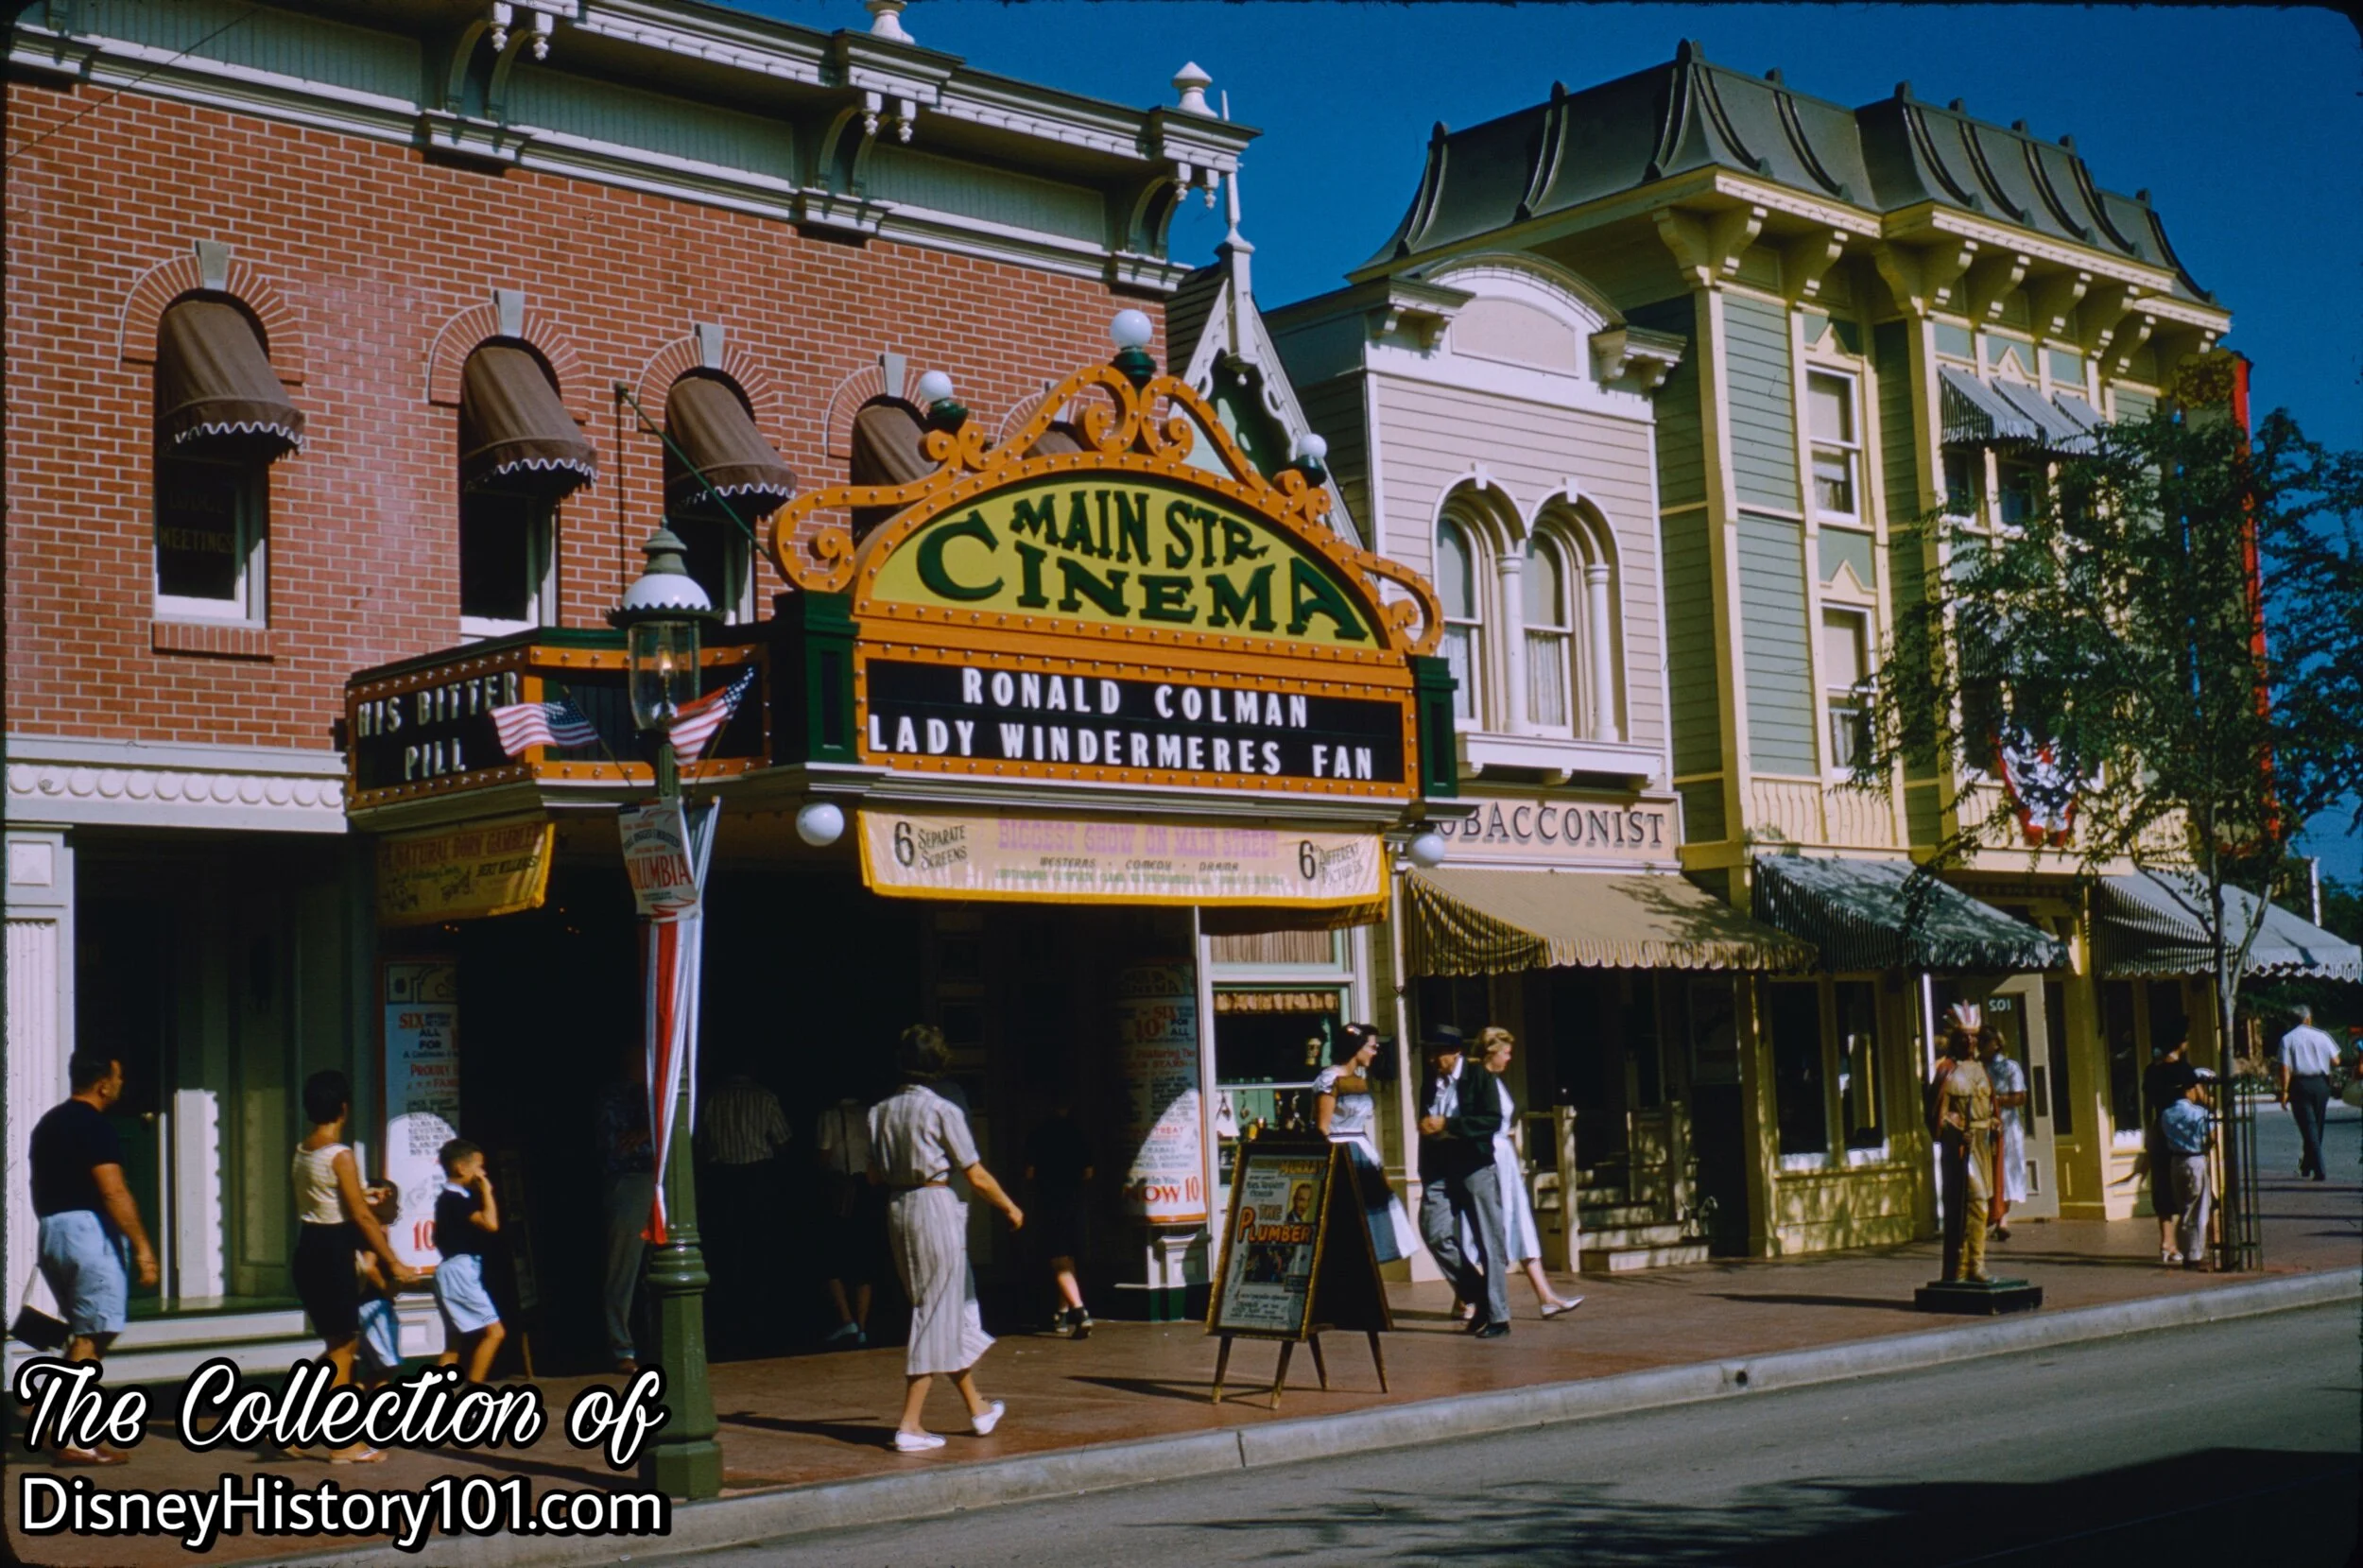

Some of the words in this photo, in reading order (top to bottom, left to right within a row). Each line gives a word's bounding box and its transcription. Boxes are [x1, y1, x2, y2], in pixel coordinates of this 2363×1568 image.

[159, 526, 235, 555] MEETINGS
[1009, 489, 1151, 567] MAIN
[916, 509, 1370, 641] CINEMA
[357, 697, 402, 738] HIS
[417, 671, 518, 727] BITTER
[962, 667, 1120, 715] RONALD
[1156, 684, 1308, 729] COLMAN
[405, 737, 466, 782] PILL
[868, 714, 975, 758] LADY
[999, 723, 1282, 776] WINDERMERES
[1312, 744, 1373, 782] FAN
[918, 824, 966, 851] SEPARATE
[997, 818, 1076, 853] BIGGEST
[1084, 823, 1137, 854] SHOW
[1145, 825, 1168, 856] ON
[1174, 827, 1216, 857] MAIN
[1223, 829, 1278, 859] STREET
[1438, 801, 1664, 844] BACCONIST
[894, 820, 915, 868] 6
[920, 845, 969, 870] SCREENS
[1299, 839, 1316, 882] 6
[627, 853, 693, 889] OLUMBIA
[399, 1012, 424, 1029] SIX
[418, 1027, 441, 1038] ALL
[418, 1039, 442, 1050] FOR
[1236, 1205, 1313, 1245] PLUMBER
[1258, 1203, 1283, 1221] THE
